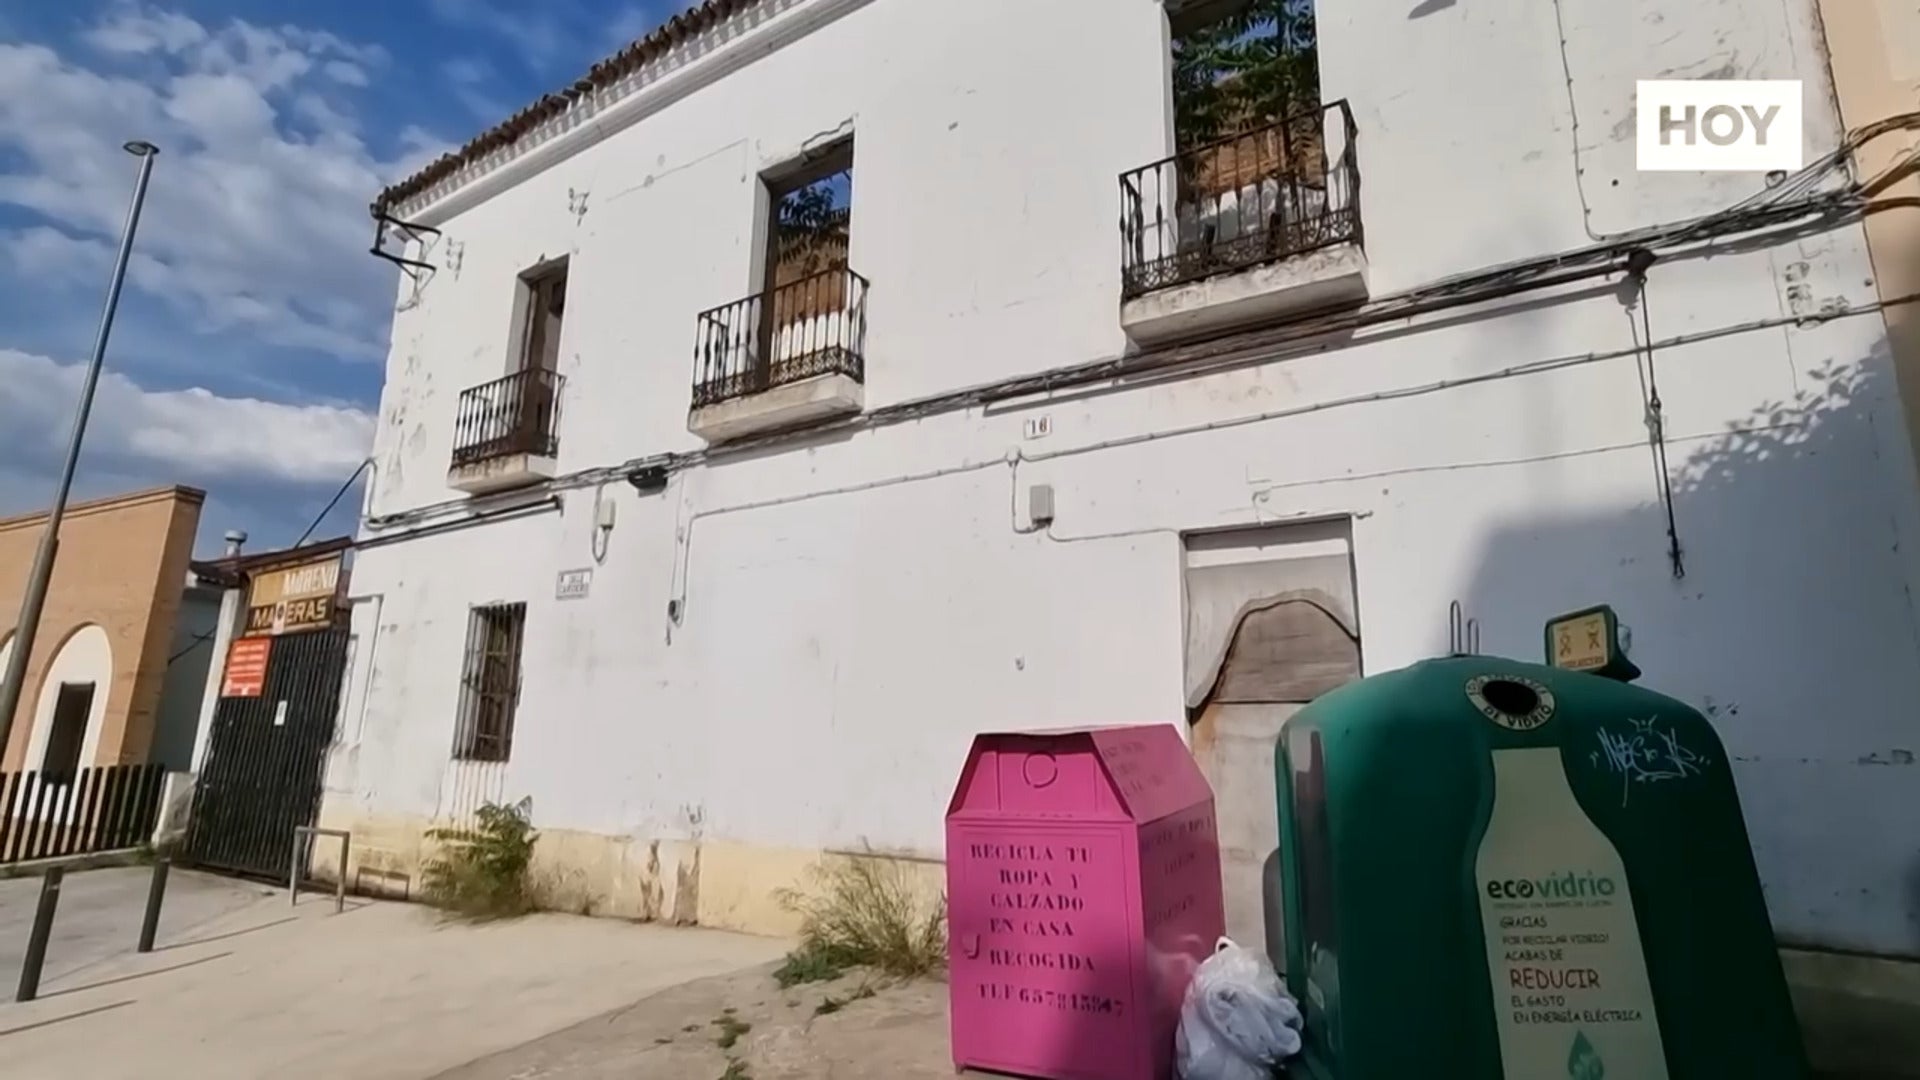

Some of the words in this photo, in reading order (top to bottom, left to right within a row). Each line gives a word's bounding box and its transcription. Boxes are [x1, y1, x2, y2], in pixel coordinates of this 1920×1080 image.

[1507, 704, 1552, 727] VIDRIO
[970, 844, 1054, 861] RECICLA
[1067, 847, 1092, 862] TU
[1000, 869, 1052, 887] ROPA
[1070, 874, 1083, 890] Y
[1487, 870, 1616, 899] ecovidrio
[991, 893, 1084, 911] CALZADO
[989, 918, 1014, 933] EN
[1023, 921, 1074, 936] CASA
[1500, 915, 1548, 928] GRACIAS
[1502, 935, 1520, 945] POR
[1523, 934, 1568, 945] RECICLAR
[989, 950, 1095, 971] RECOGIDA
[1504, 950, 1547, 961] ACABAS
[1549, 949, 1564, 961] DE
[1509, 968, 1601, 989] REDUCIR
[1511, 995, 1524, 1008] EL
[1527, 995, 1565, 1007] GASTO
[1513, 1011, 1529, 1024] EN
[1531, 1009, 1582, 1023] ENERGÍA
[1583, 1008, 1642, 1023] ELÉCTRICA
